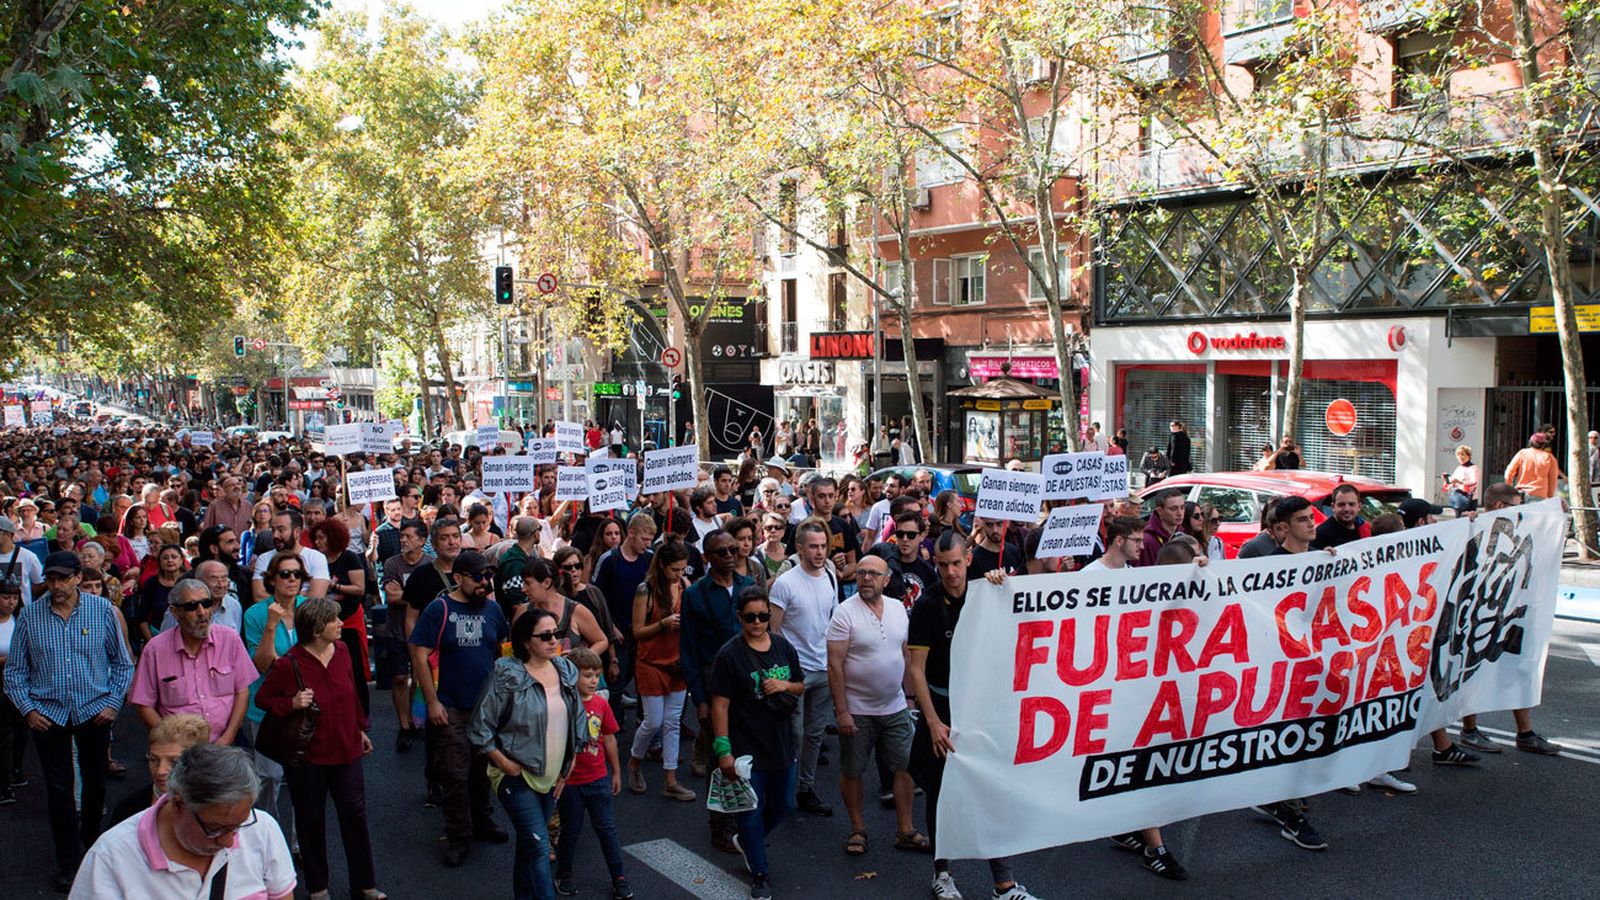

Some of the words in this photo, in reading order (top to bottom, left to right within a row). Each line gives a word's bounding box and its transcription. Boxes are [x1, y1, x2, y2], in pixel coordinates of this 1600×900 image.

[1210, 332, 1286, 350] vodafone
[780, 361, 835, 384] OASIS
[372, 426, 384, 434] NO
[483, 462, 503, 472] Ganan
[504, 462, 531, 474] siempre:
[612, 463, 635, 474] CASAS
[645, 457, 667, 470] Ganan
[667, 453, 695, 467] siempre:
[1076, 458, 1103, 471] CASAS
[1104, 461, 1125, 474] ASAS
[483, 478, 503, 487] crean
[504, 477, 531, 487] adictos.
[559, 472, 574, 480] Ganan
[608, 475, 624, 488] CASAS
[645, 475, 666, 487] crean
[666, 471, 695, 484] adictos.
[558, 487, 574, 495] crean
[982, 475, 1007, 490] Ganan
[1008, 478, 1041, 496] siempre:
[1045, 479, 1058, 493] DE
[1059, 476, 1102, 491] APUESTAS!
[592, 495, 600, 506] DE
[979, 498, 1004, 511] crean
[1005, 498, 1037, 514] adictos.
[1048, 515, 1070, 530] Ganan
[1070, 513, 1099, 530] siempre:
[1041, 538, 1062, 551] crean
[1062, 535, 1092, 550] adictos.
[1013, 588, 1080, 614] ELLOS
[1085, 586, 1112, 608] SE
[1118, 579, 1211, 604] LUCRAN,
[1217, 576, 1238, 598] LA
[1242, 567, 1300, 592] CLASE
[1301, 557, 1358, 585] OBRERA
[1361, 552, 1376, 571] SE
[1376, 536, 1444, 564] ARRUINA
[1013, 603, 1249, 692] FUERA
[1274, 562, 1439, 660] CASAS
[1013, 689, 1112, 766] DE
[1132, 625, 1432, 748] APUESTAS
[1088, 755, 1137, 792] DE
[1145, 721, 1326, 781] NUESTROS
